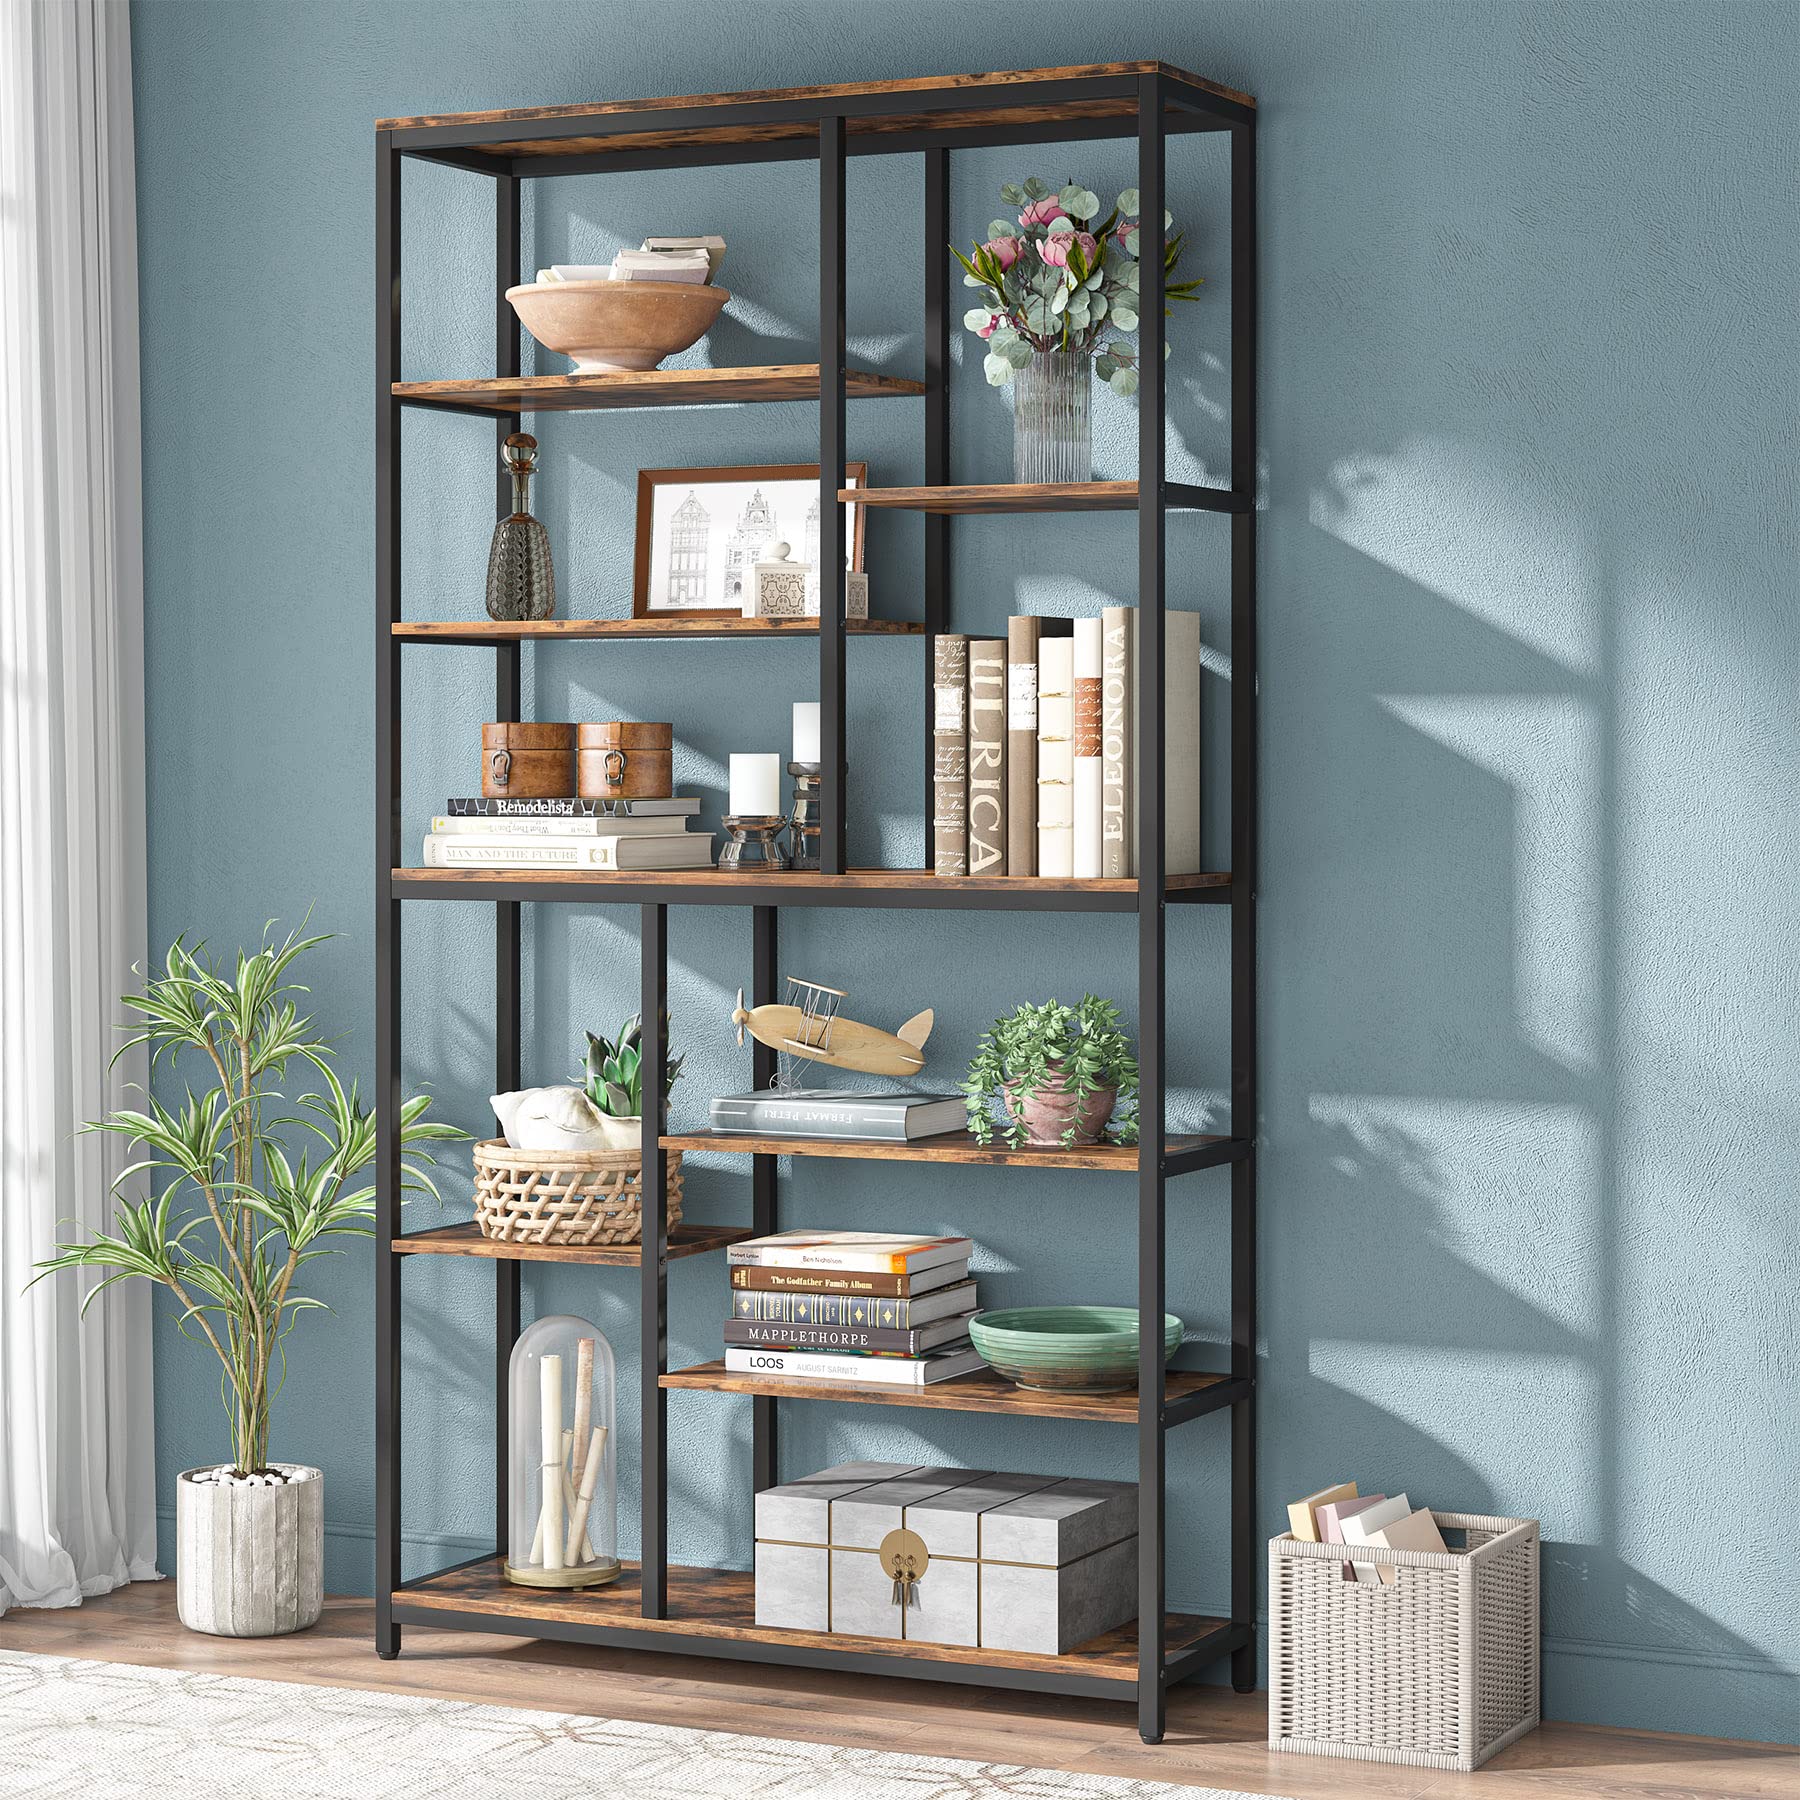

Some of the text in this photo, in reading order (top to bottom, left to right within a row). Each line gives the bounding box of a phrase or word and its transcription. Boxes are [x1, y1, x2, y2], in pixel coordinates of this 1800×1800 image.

[1103, 625, 1126, 842] ELEONORA
[971, 657, 1004, 874] ULRICA
[498, 800, 574, 814] Remodelista
[512, 824, 529, 833] They
[530, 825, 549, 834] What
[446, 849, 578, 860] MAN AND THE FUTURE
[763, 1109, 853, 1124] FERMAT PETRI
[815, 1256, 843, 1265] Nicholson
[771, 1275, 873, 1290] The Godfather Family Album
[748, 1328, 869, 1346] MAPPLETHORPE
[750, 1357, 784, 1370] LOOS
[796, 1363, 858, 1375] AUGUST SARNITZ
